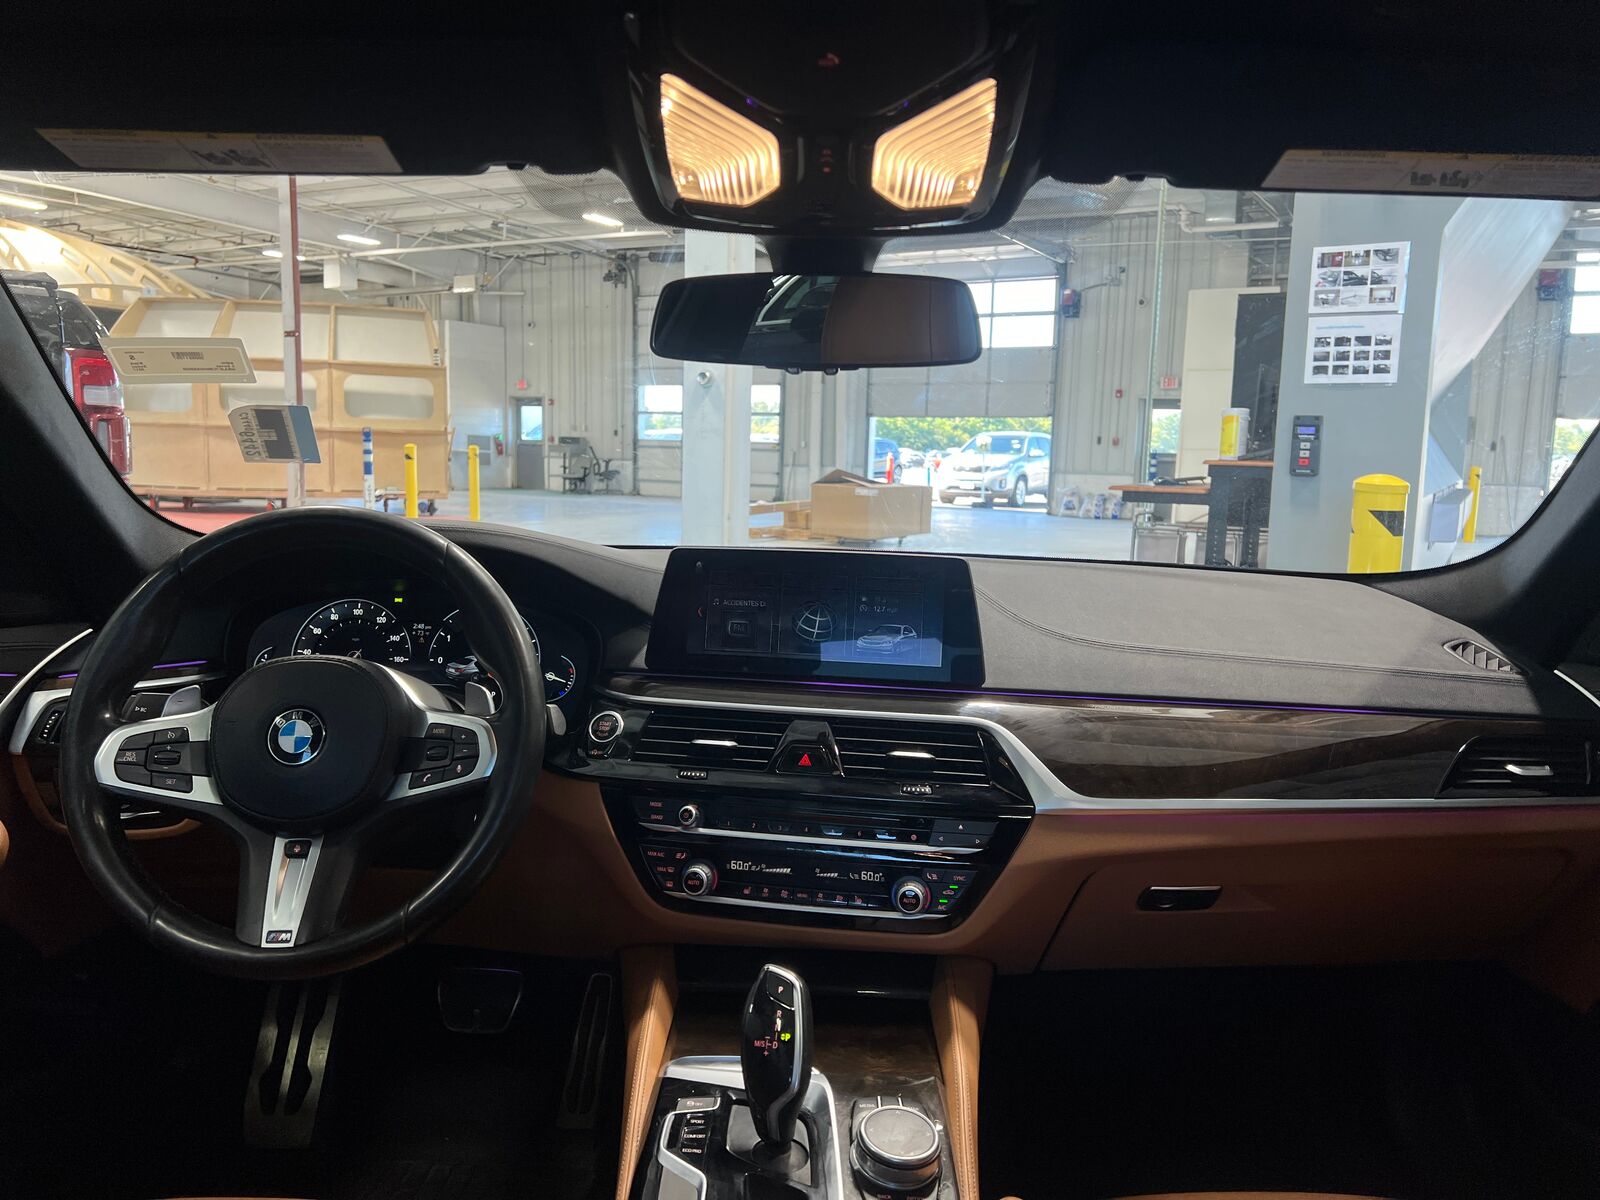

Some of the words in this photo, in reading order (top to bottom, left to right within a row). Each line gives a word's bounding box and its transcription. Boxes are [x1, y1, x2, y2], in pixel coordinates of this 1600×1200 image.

[722, 599, 759, 607] ACCIDENTES
[352, 608, 364, 616] 100
[330, 613, 339, 621] 80
[313, 627, 322, 635] 60
[389, 634, 400, 642] 140
[446, 634, 450, 642] 1
[437, 656, 443, 664] 0
[275, 711, 320, 728] BMW
[778, 986, 783, 994] P
[776, 1010, 782, 1018] R
[772, 1041, 778, 1049] D
